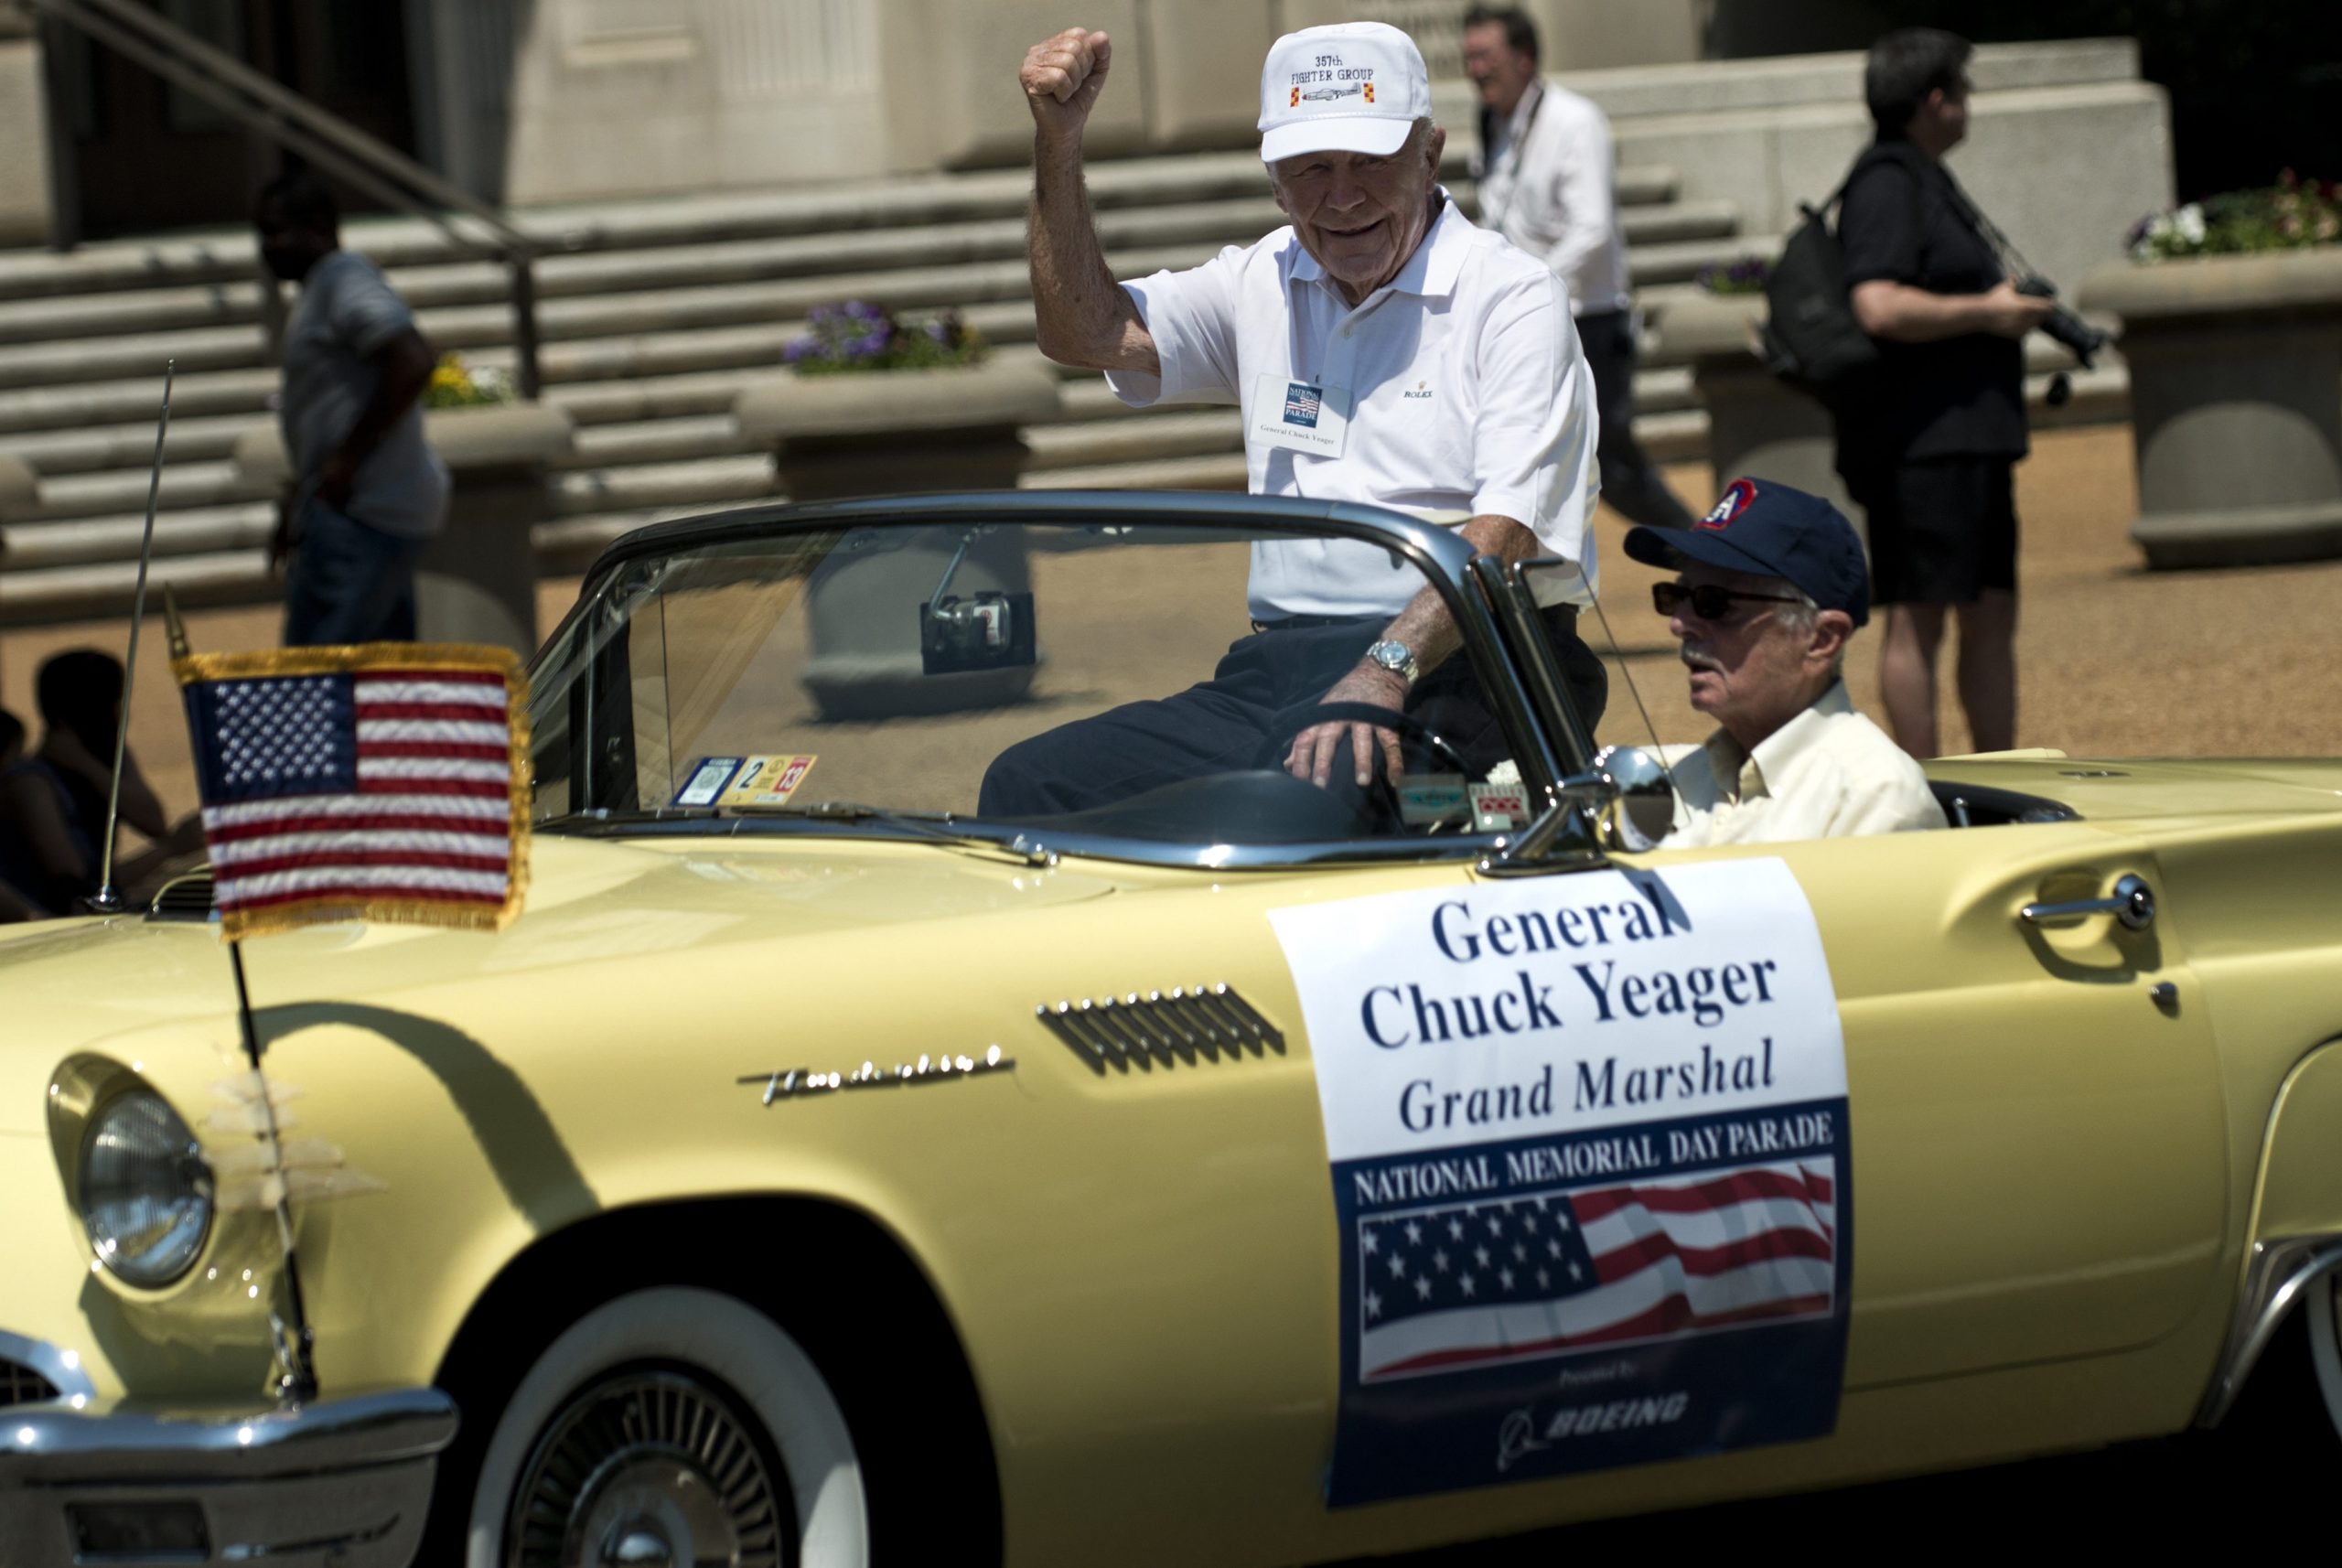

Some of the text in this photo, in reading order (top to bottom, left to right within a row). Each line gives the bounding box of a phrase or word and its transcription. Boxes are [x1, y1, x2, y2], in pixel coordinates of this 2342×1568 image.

[1316, 56, 1343, 67] 357th
[1292, 69, 1373, 84] FIGHTER GROUP
[1403, 390, 1433, 398] ROLEX
[1285, 409, 1316, 420] PARADE
[1261, 424, 1335, 445] General Chuck Yeager
[739, 761, 764, 788] 2
[1432, 886, 1677, 962] General
[1360, 957, 1777, 1049] Chuck Yeager
[1399, 1037, 1775, 1133] Grand Marshal
[1354, 1112, 1833, 1206] NATIONAL MEMORIAL DAY PARADE
[1546, 1391, 1690, 1437] BOEING
